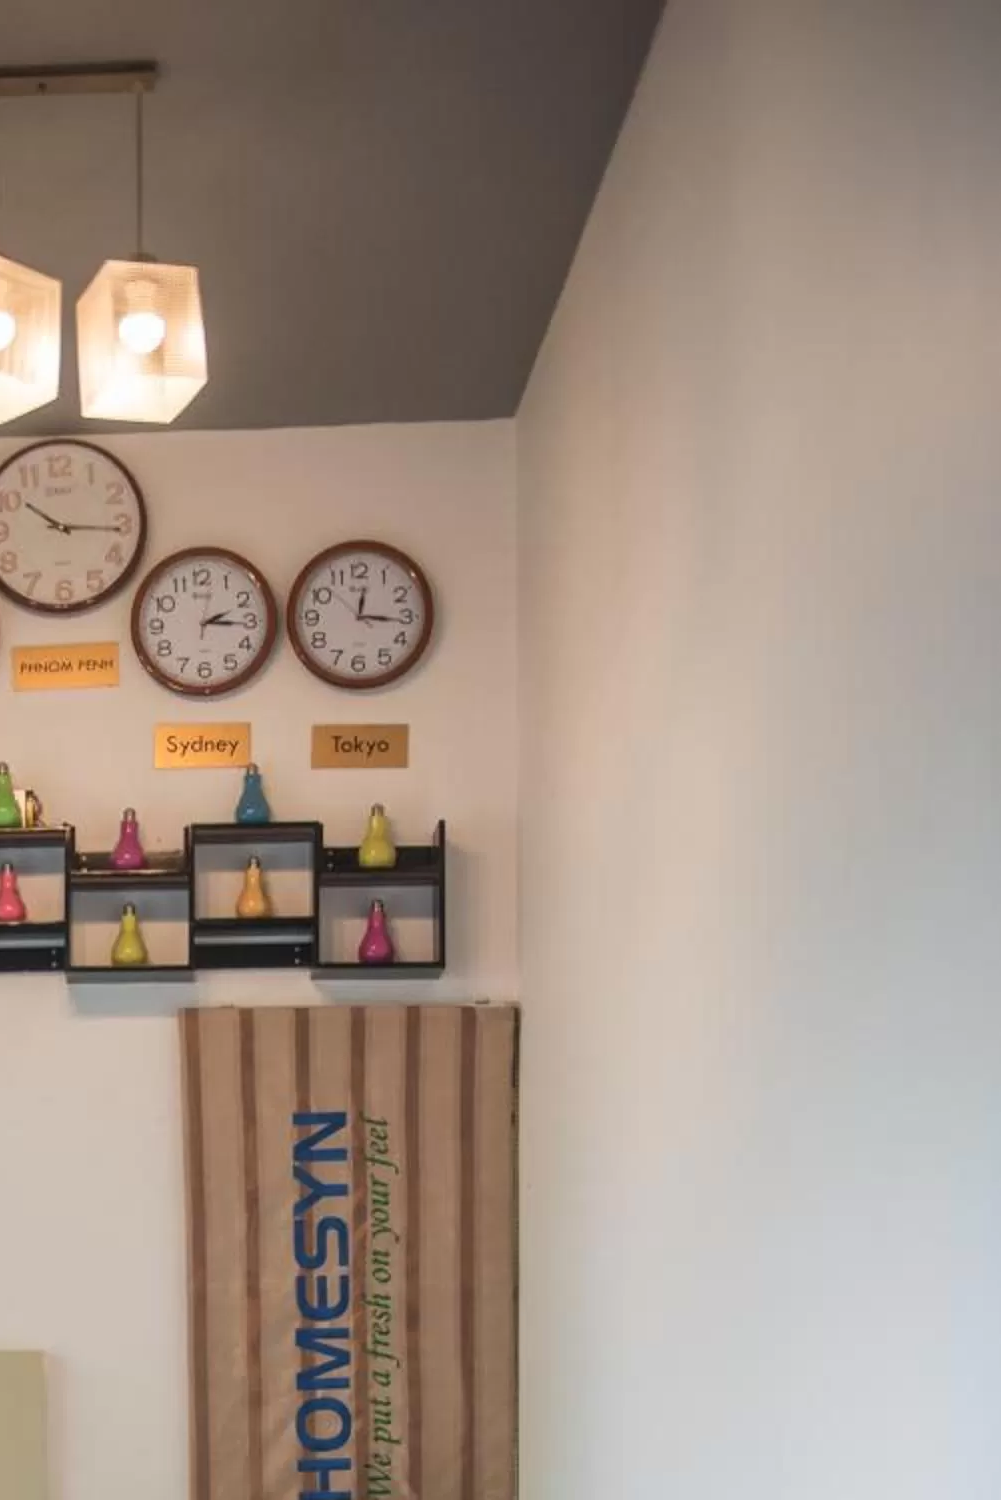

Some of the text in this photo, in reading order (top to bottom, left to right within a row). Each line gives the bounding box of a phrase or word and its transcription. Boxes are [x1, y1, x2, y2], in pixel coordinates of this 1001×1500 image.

[46, 456, 72, 478] 12
[20, 464, 39, 488] 11
[105, 482, 124, 504] 2
[114, 513, 132, 536] 3
[0, 551, 17, 573] 8
[105, 543, 124, 565] 4
[193, 569, 211, 586] 12
[331, 570, 344, 586] 11
[351, 562, 368, 579] 12
[23, 571, 41, 595] 7
[87, 569, 103, 592] 5
[173, 577, 186, 593] 11
[55, 580, 73, 601] 6
[313, 587, 332, 604] 10
[393, 587, 408, 603] 2
[156, 595, 175, 613] 10
[236, 592, 250, 608] 2
[243, 613, 257, 629] 3
[305, 610, 320, 627] 9
[400, 608, 413, 624] 3
[150, 619, 164, 635] 9
[239, 636, 252, 651] 4
[311, 632, 327, 648] 8
[394, 631, 407, 646] 4
[157, 640, 172, 656] 8
[177, 657, 190, 673] 7
[223, 654, 238, 671] 5
[330, 650, 343, 666] 7
[351, 655, 366, 672] 6
[378, 648, 392, 666] 5
[198, 662, 212, 678] 6
[166, 736, 240, 758] Sydney
[330, 736, 390, 757] Tokyo
[359, 1111, 401, 1500] We put a fresh on your feel
